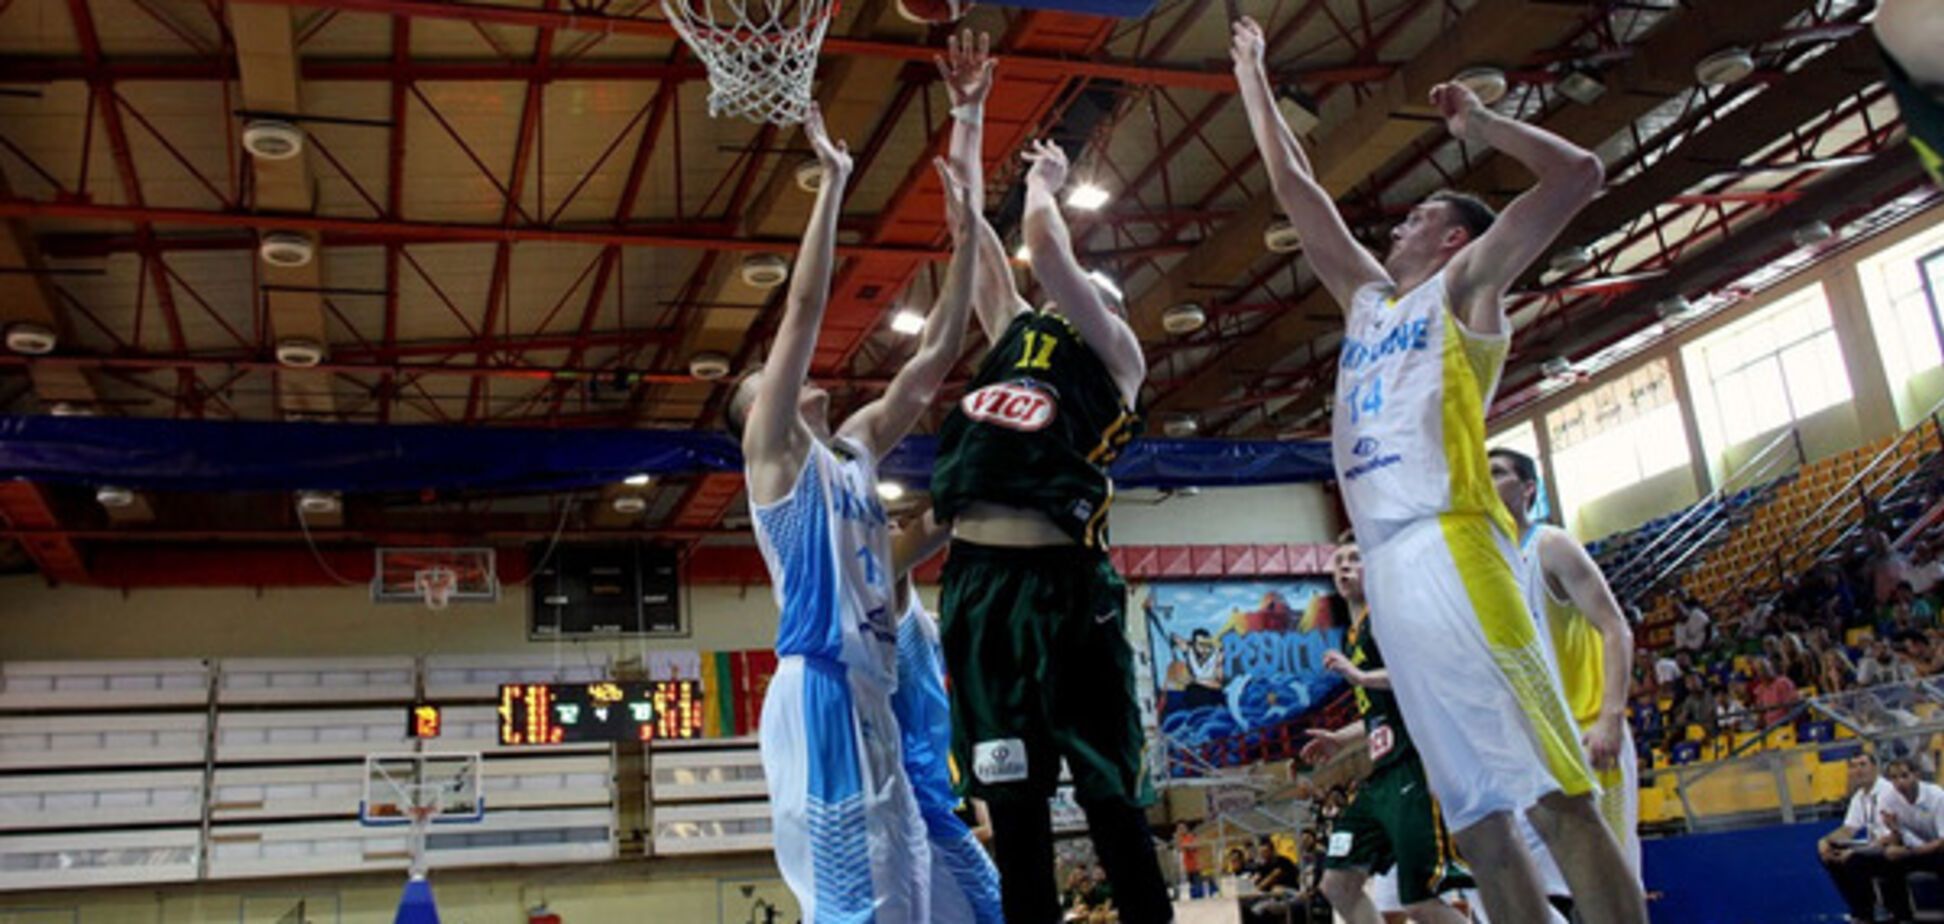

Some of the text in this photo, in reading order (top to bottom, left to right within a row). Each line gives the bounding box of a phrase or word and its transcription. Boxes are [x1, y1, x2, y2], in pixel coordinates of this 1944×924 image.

[1015, 329, 1058, 369] 11
[972, 390, 1044, 421] VICI
[1346, 376, 1383, 425] 14
